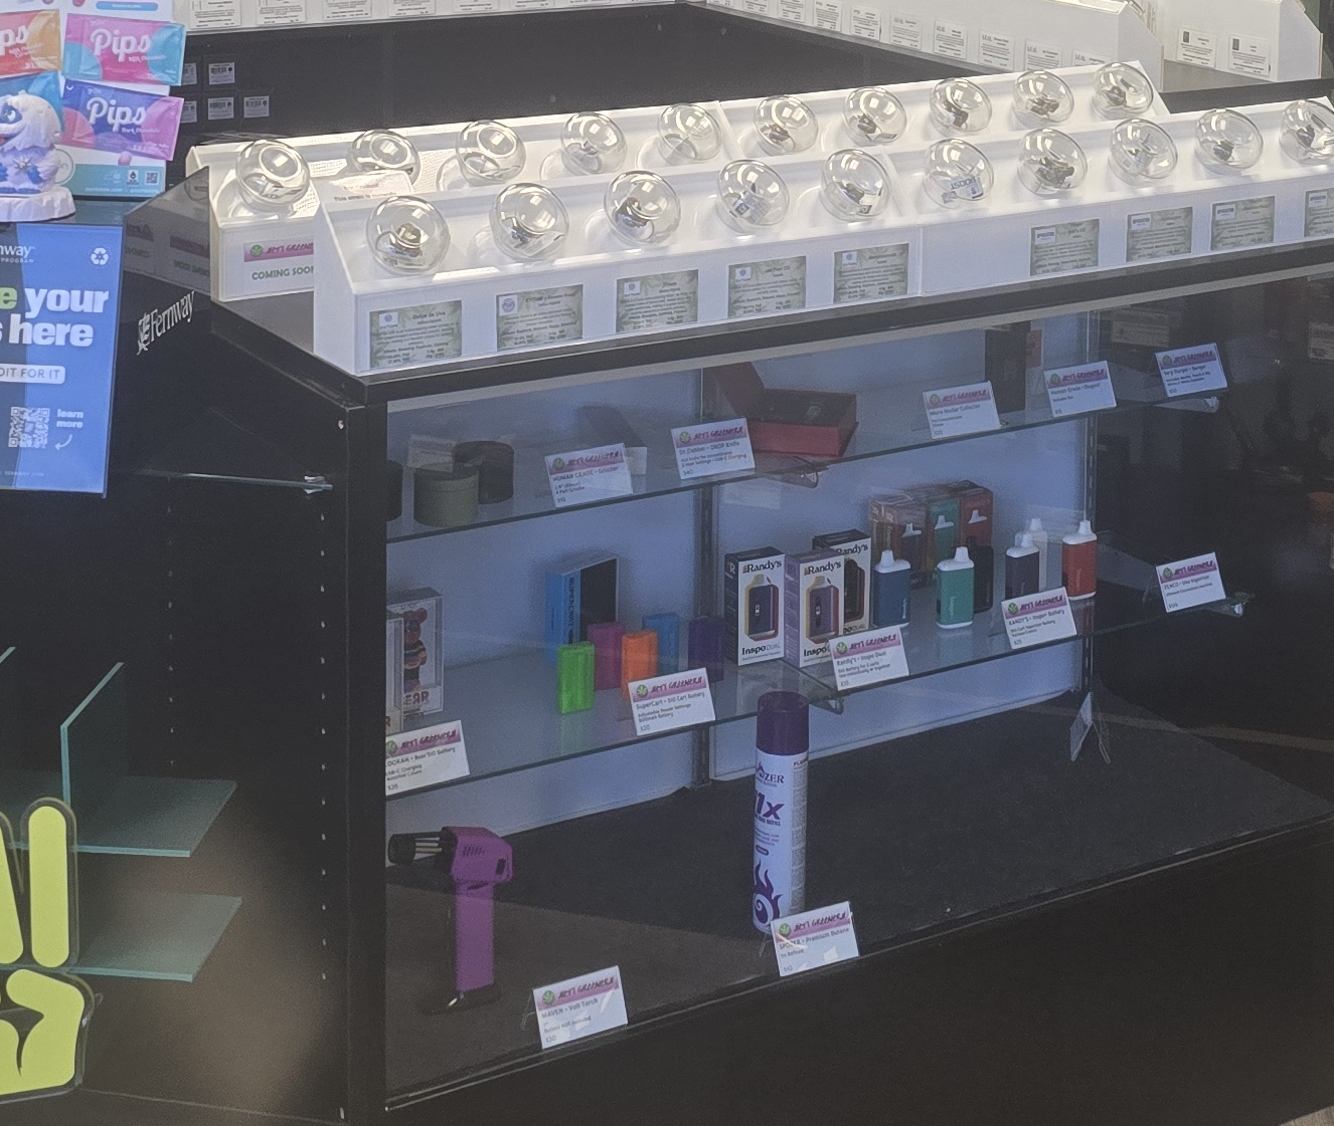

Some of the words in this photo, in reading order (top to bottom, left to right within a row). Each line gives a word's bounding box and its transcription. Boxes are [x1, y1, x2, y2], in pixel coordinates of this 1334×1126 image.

[90, 29, 152, 62] Pips
[86, 97, 146, 132] Pips
[252, 268, 291, 281] COMING
[25, 289, 109, 318] your
[149, 291, 195, 344] Fernway
[8, 314, 94, 347] here
[21, 368, 45, 378] FOR
[48, 370, 60, 379] IT
[57, 409, 84, 419] learn
[57, 420, 83, 428] more
[748, 560, 782, 571] Randy's
[808, 562, 841, 574] Randy's
[651, 683, 667, 694] JETT
[669, 676, 703, 691] GREENERY
[636, 700, 663, 709] SuperCart
[688, 691, 705, 700] Battery
[794, 922, 811, 933] JETT
[812, 912, 850, 928] GREENERY
[559, 988, 577, 999] JETT
[578, 977, 616, 995] GREENERY
[542, 1007, 565, 1018] MAVEN
